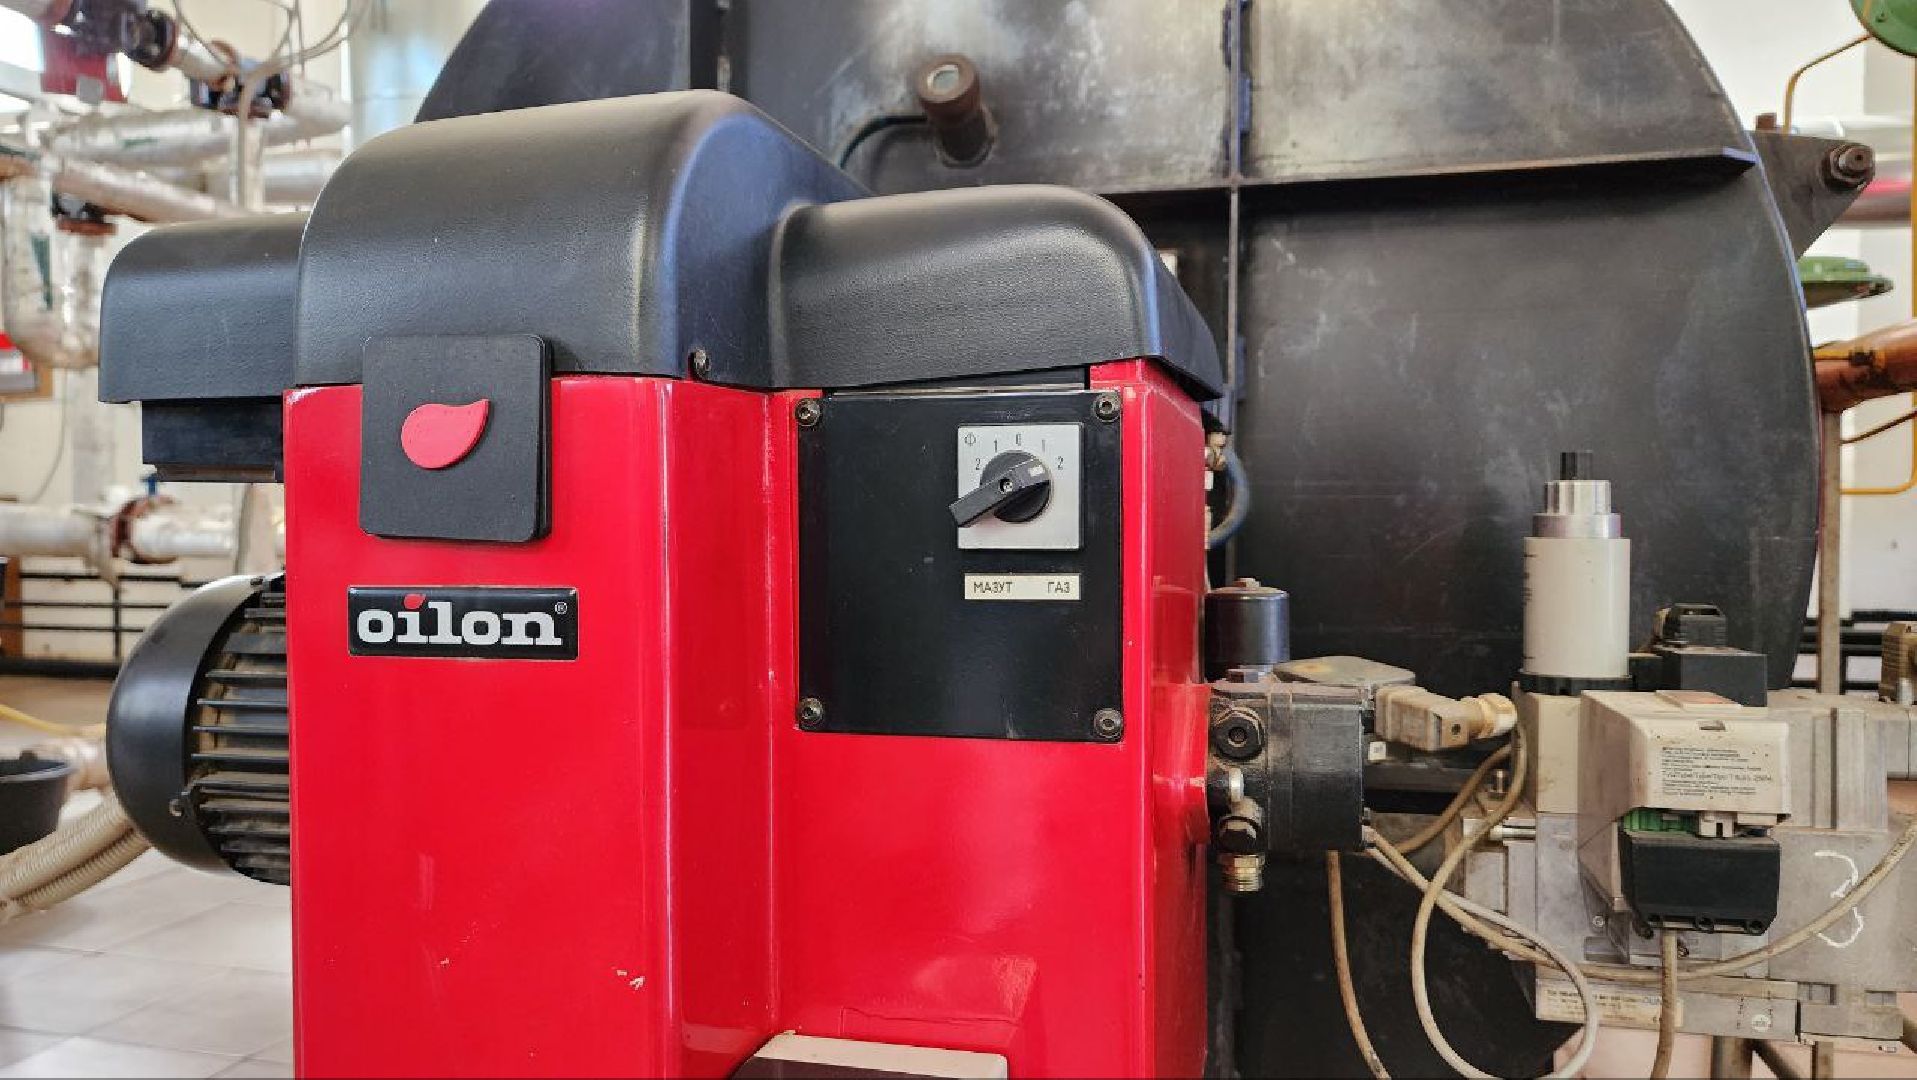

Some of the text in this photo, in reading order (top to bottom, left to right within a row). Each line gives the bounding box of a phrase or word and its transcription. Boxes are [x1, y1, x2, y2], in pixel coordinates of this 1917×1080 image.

[975, 457, 981, 471] 2
[1057, 456, 1064, 470] 2
[973, 581, 1071, 594] МАЗУТ ГАЗ
